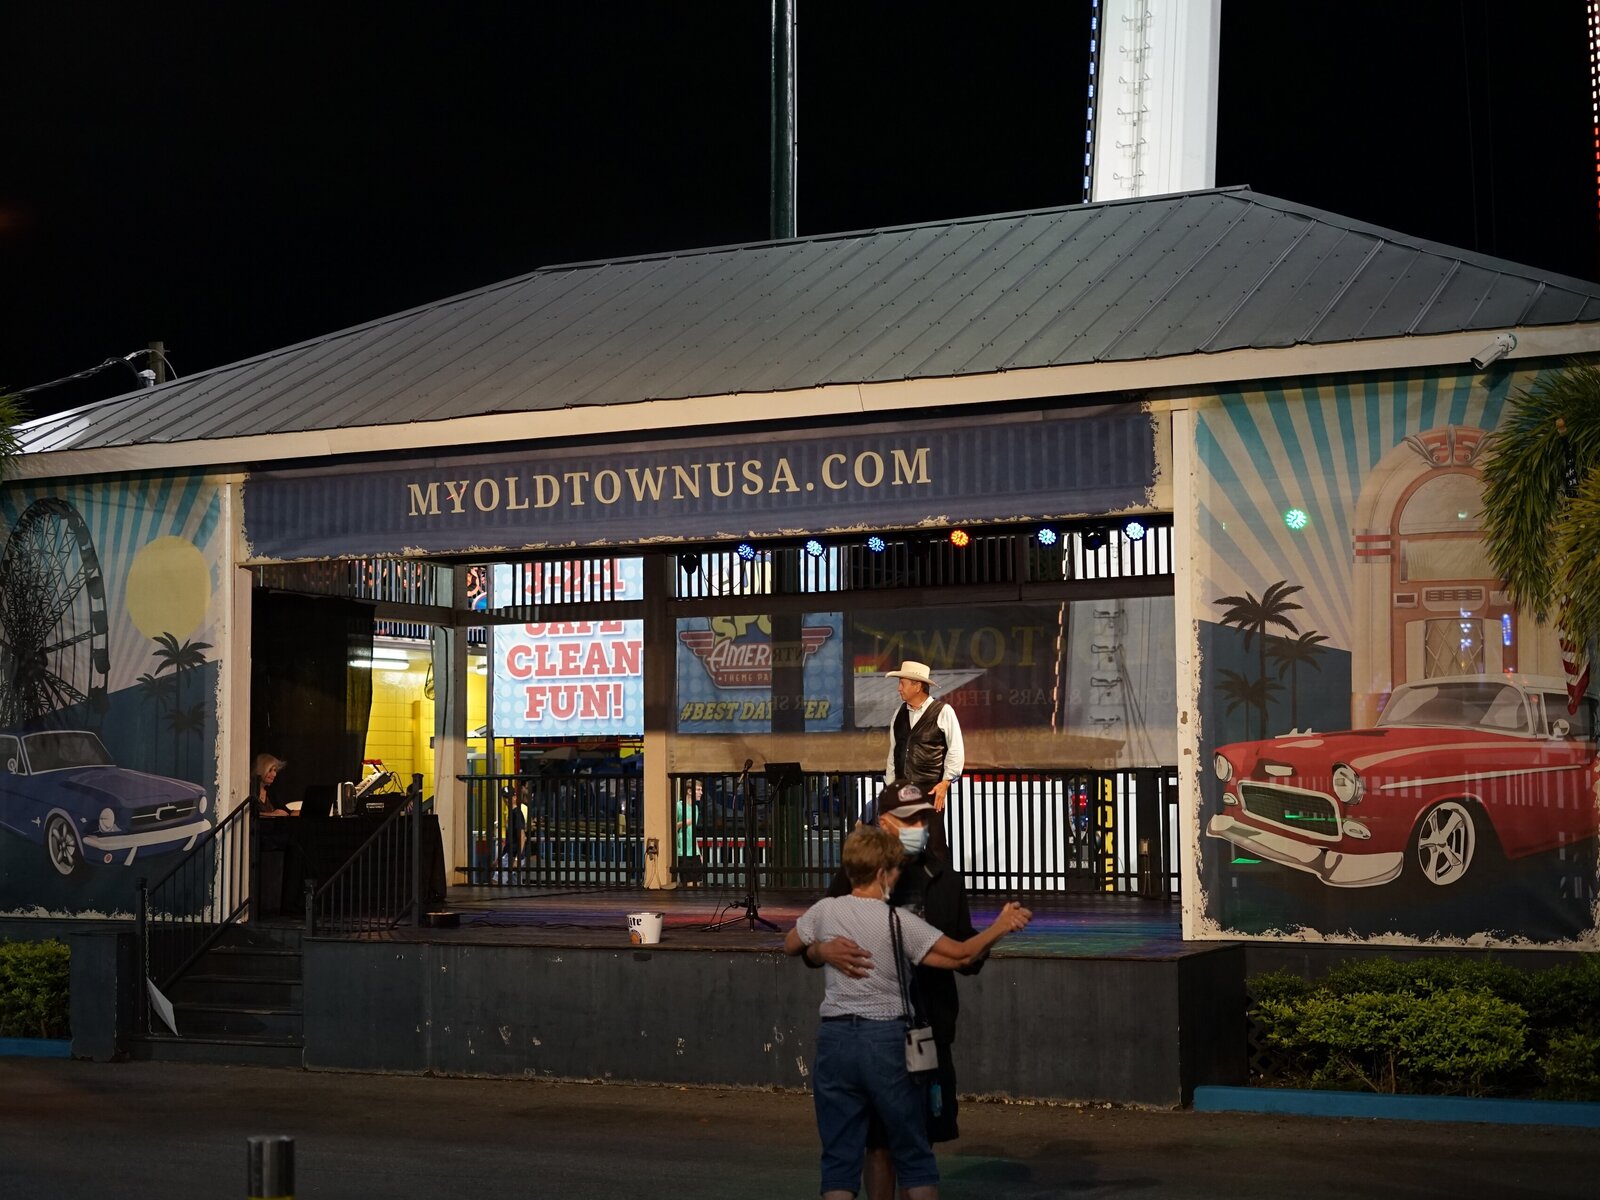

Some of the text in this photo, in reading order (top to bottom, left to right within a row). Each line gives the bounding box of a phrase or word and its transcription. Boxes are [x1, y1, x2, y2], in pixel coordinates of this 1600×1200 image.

[407, 447, 932, 516] MYOLDTOWNUSA.COM
[506, 641, 642, 678] CLEAN
[707, 640, 772, 671] AMER
[525, 684, 623, 719] FUN!
[680, 702, 739, 722] #BEST
